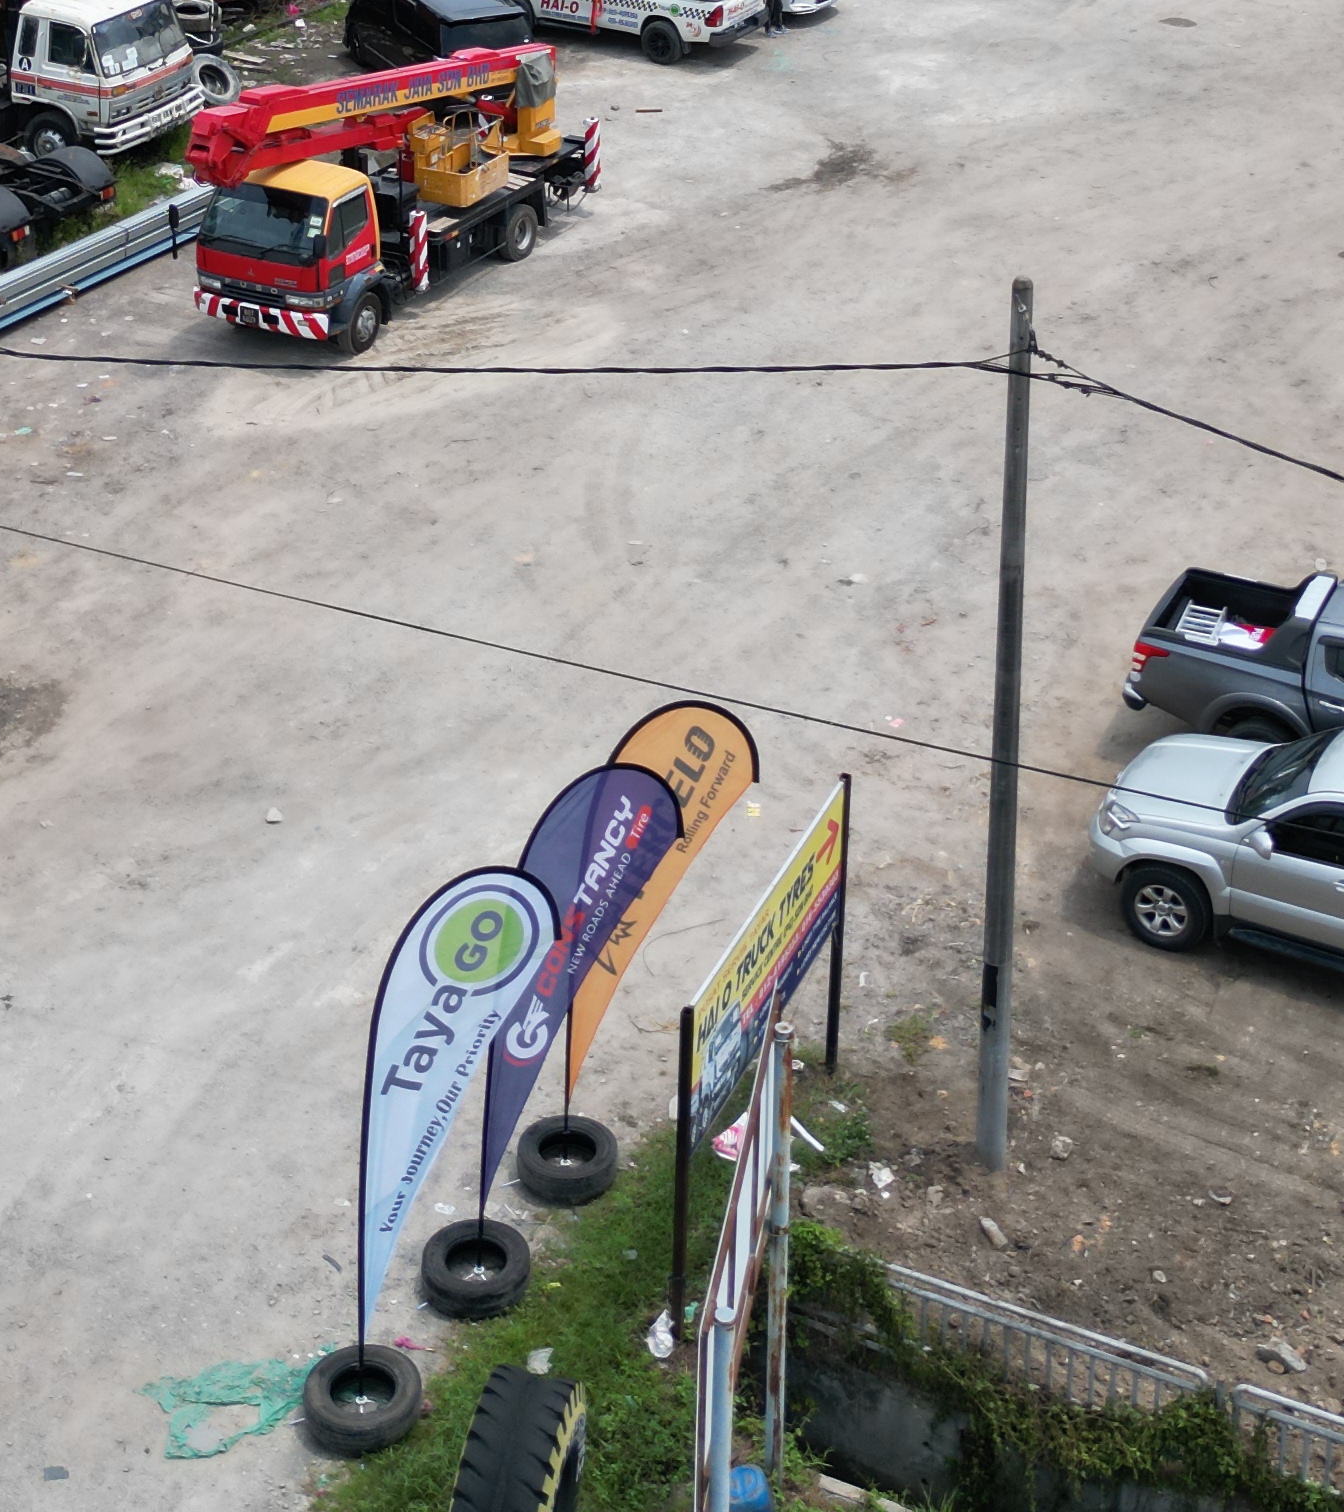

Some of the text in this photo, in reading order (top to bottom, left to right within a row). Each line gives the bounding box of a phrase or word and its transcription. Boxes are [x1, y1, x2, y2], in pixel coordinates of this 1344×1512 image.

[21, 58, 29, 71] A
[336, 80, 399, 115] SEMARAK
[403, 74, 434, 100] JAYA
[437, 69, 462, 93] SDN
[466, 63, 490, 87] BHD
[631, 812, 649, 839] Tire
[675, 749, 736, 853] Rolling Forward
[537, 795, 633, 997] CONSTANCY
[567, 851, 632, 974] NEW ROADS AHEAD
[697, 1002, 718, 1052] HAI
[721, 979, 732, 1011] O
[735, 910, 776, 992] TRUCK
[778, 852, 816, 927] TYRES
[379, 1189, 406, 1233] Your
[455, 1008, 503, 1078] Priority
